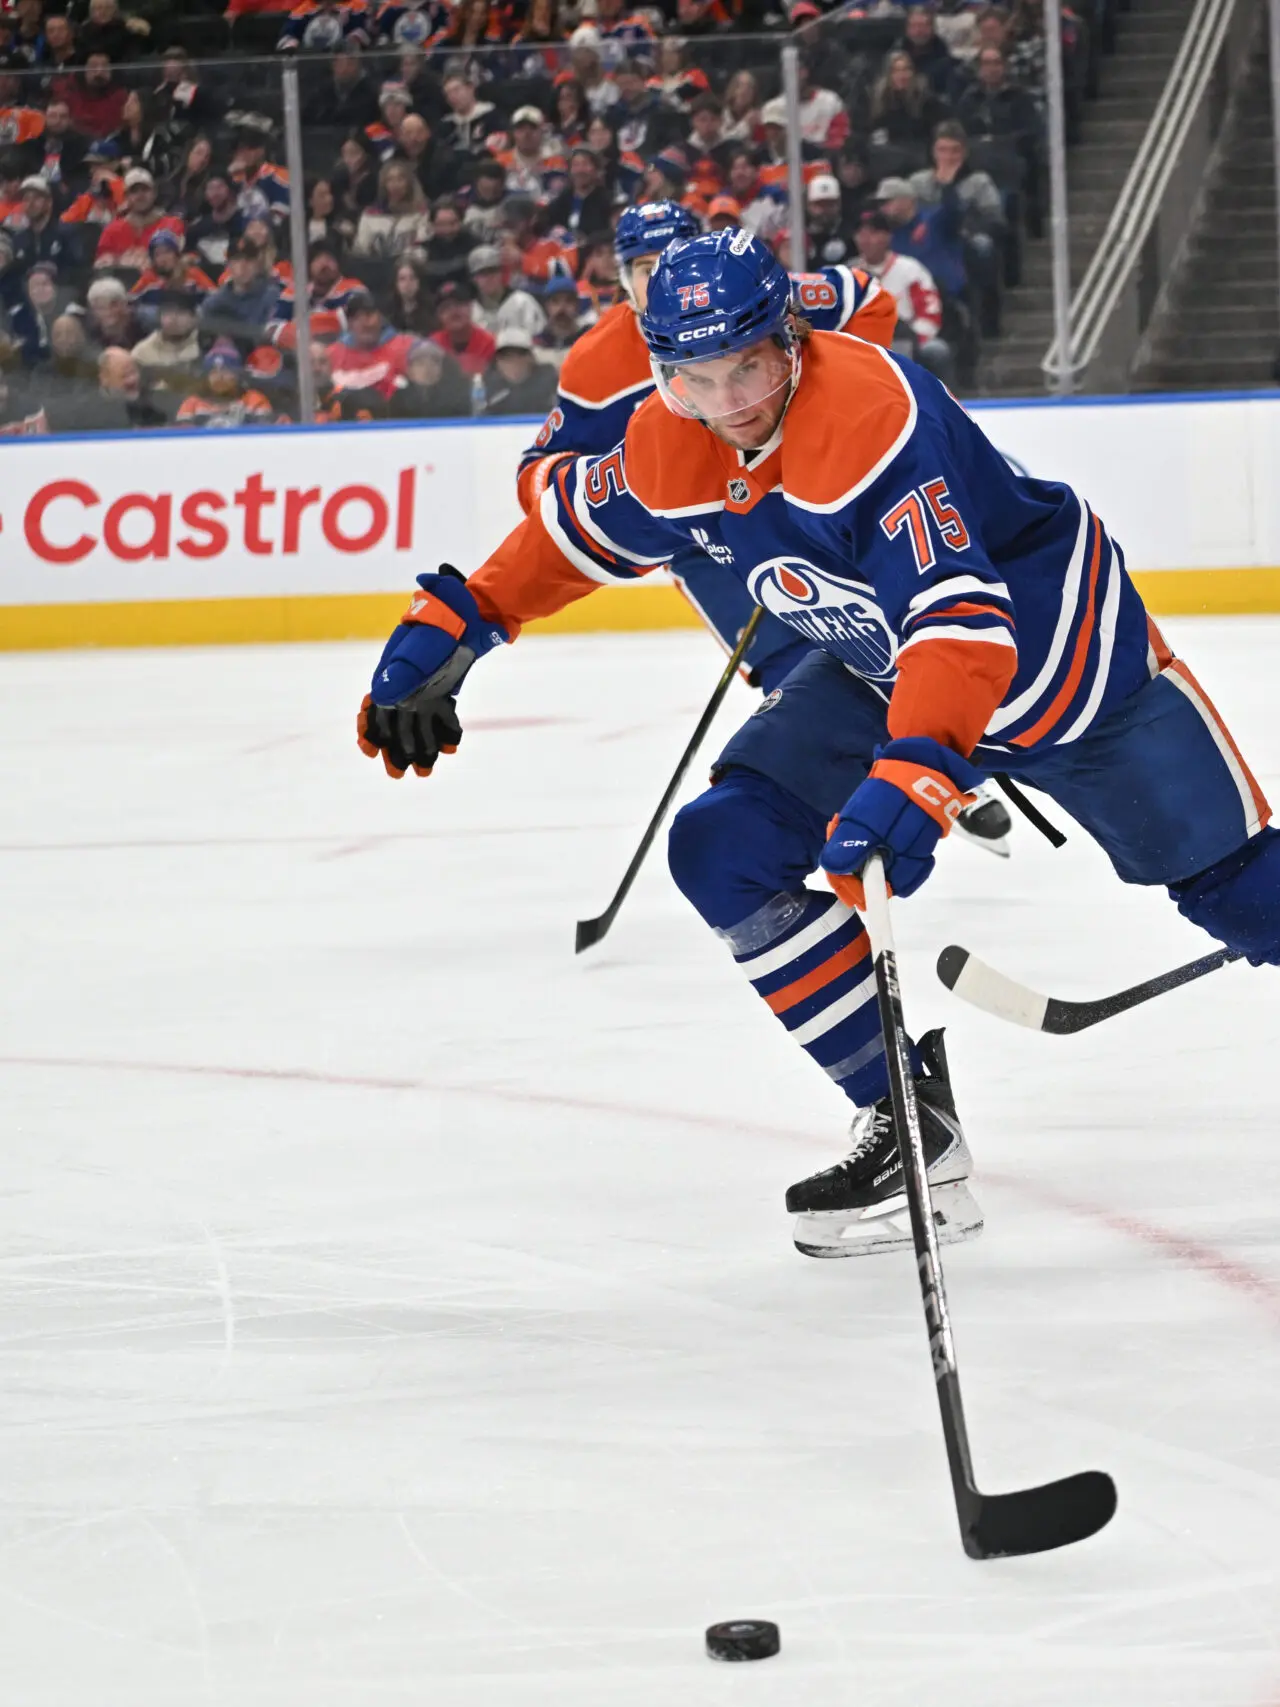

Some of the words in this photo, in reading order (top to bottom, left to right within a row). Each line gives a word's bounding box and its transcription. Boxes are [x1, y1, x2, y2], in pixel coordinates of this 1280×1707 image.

[677, 282, 710, 311] 75
[678, 322, 726, 342] CCM
[23, 464, 418, 564] Castrol
[879, 476, 971, 575] 75
